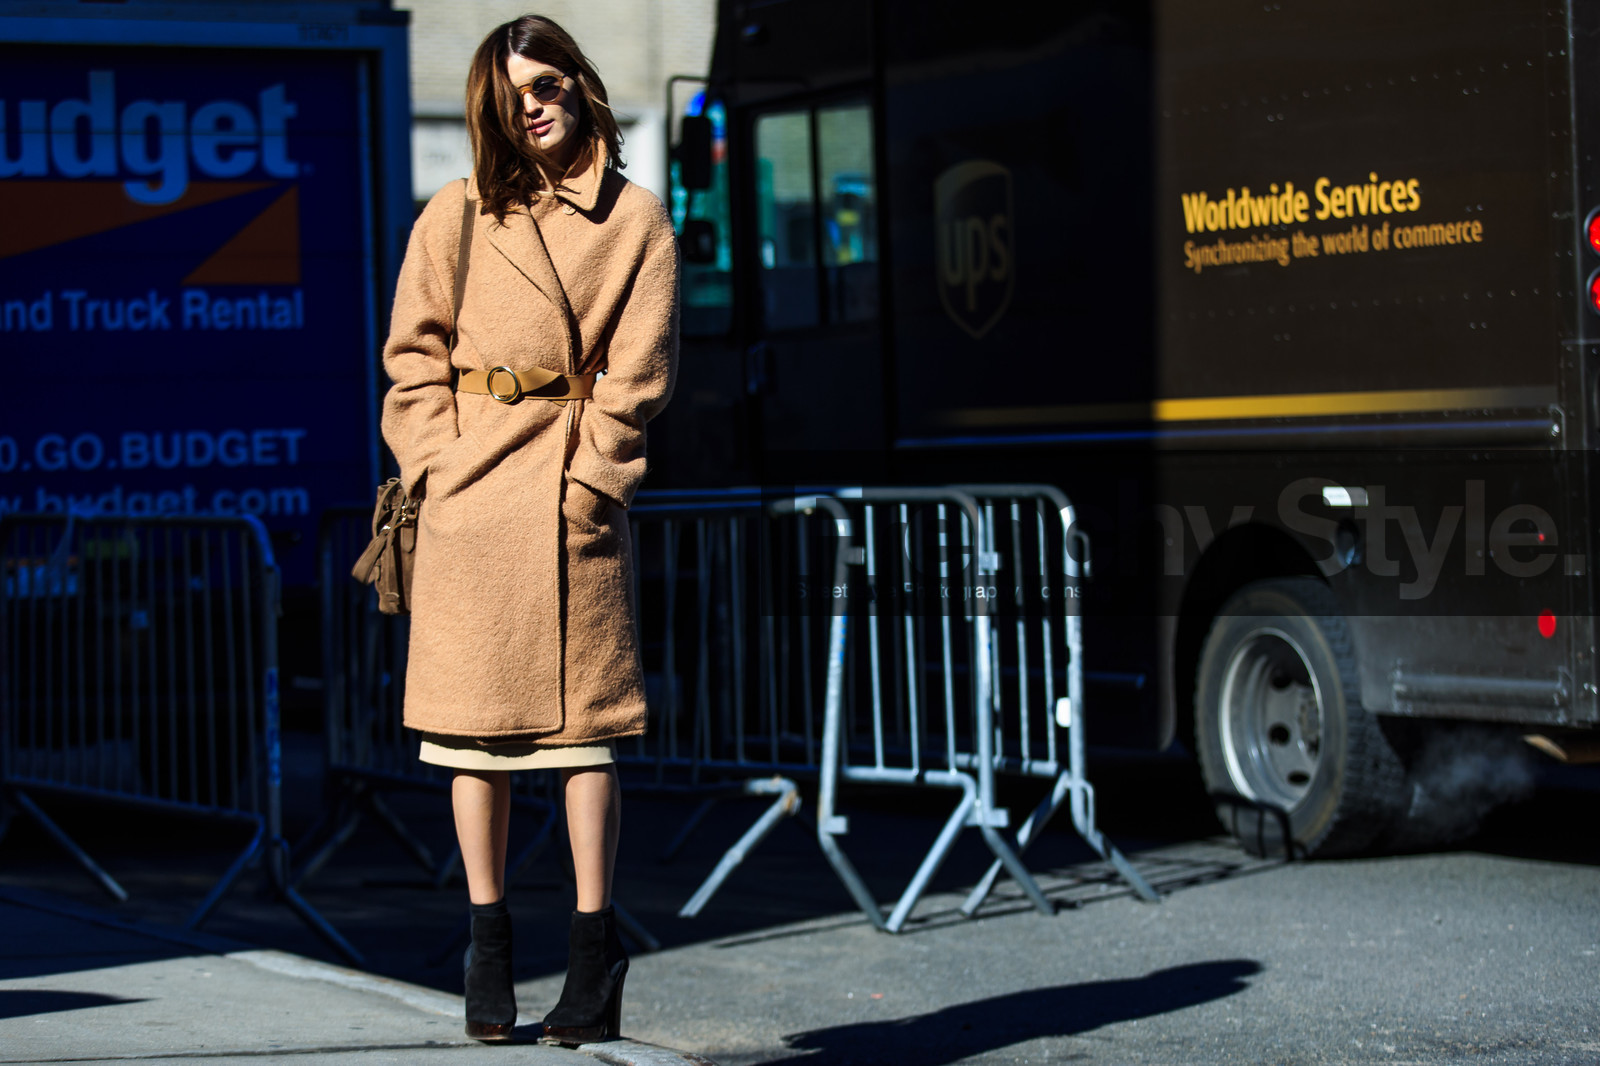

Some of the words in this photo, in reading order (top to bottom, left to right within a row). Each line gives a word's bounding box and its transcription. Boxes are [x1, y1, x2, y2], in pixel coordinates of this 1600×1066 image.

[1182, 180, 1309, 233] Worldwide
[1315, 172, 1421, 220] Services
[1184, 233, 1290, 273] Synchronizing
[1292, 230, 1319, 257] the
[1322, 223, 1369, 255] world
[1372, 220, 1390, 250] of
[1393, 220, 1483, 249] commerce
[0, 289, 53, 332] nd
[61, 288, 172, 332] Truck
[181, 284, 304, 332] Rental
